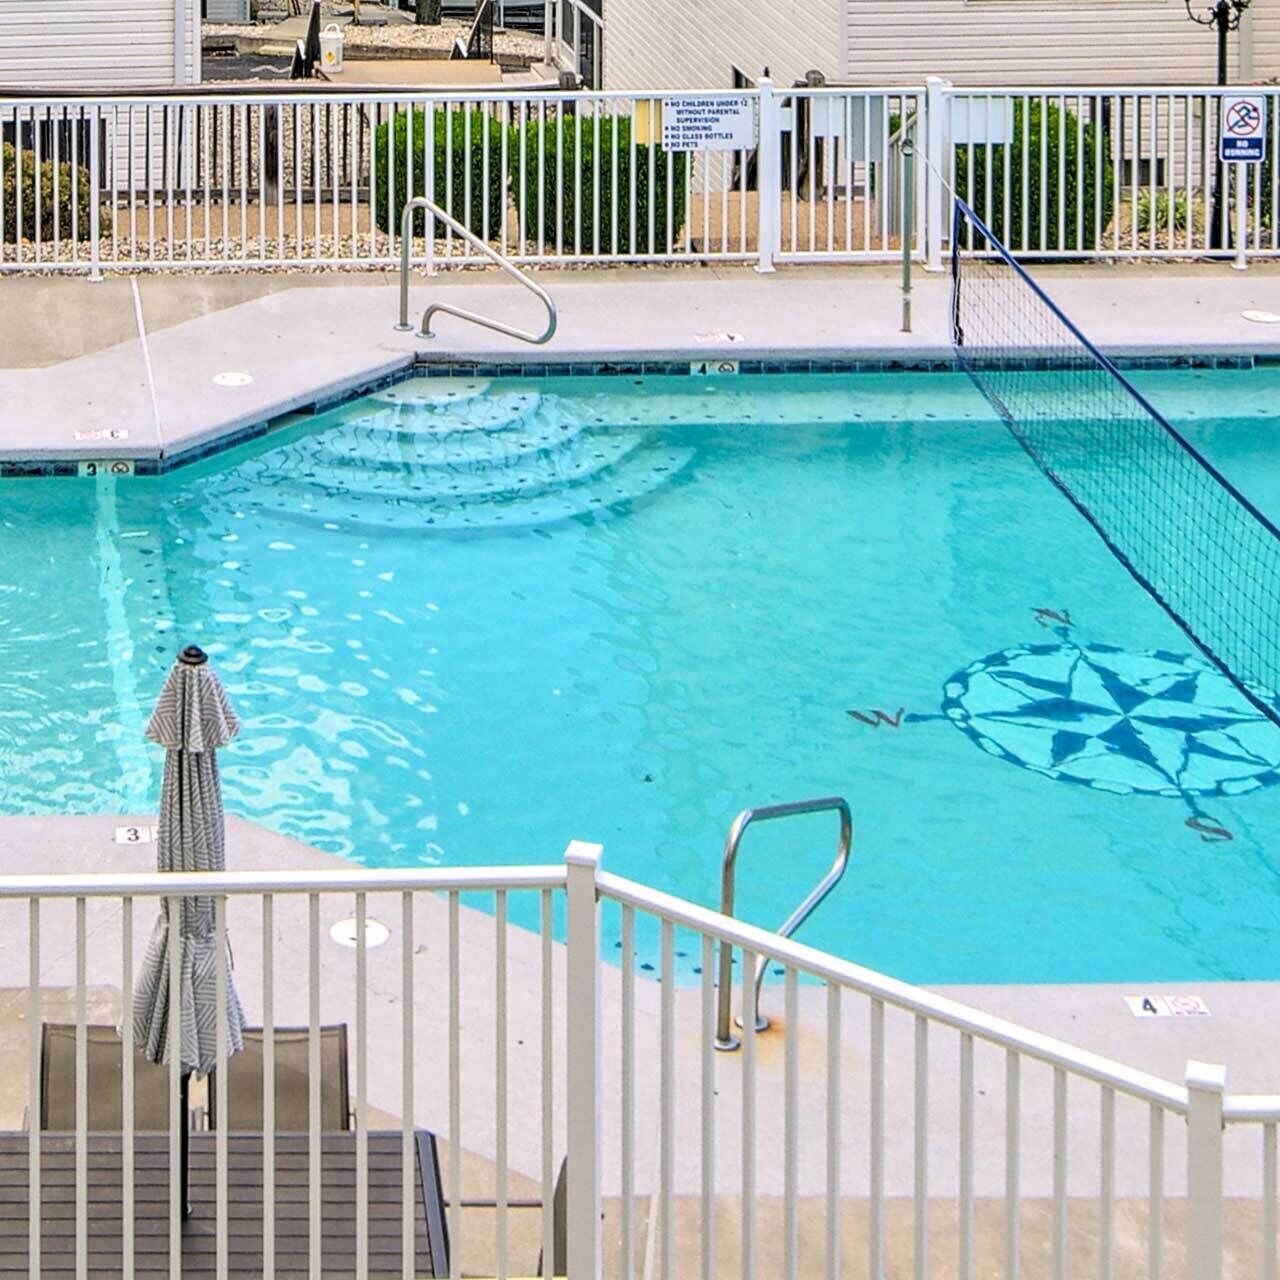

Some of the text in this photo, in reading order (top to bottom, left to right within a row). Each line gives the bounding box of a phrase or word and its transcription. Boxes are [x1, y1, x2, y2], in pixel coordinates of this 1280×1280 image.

[1236, 140, 1249, 148] NO
[86, 462, 97, 476] 3
[126, 827, 140, 842] 3
[1142, 997, 1158, 1015] 4
